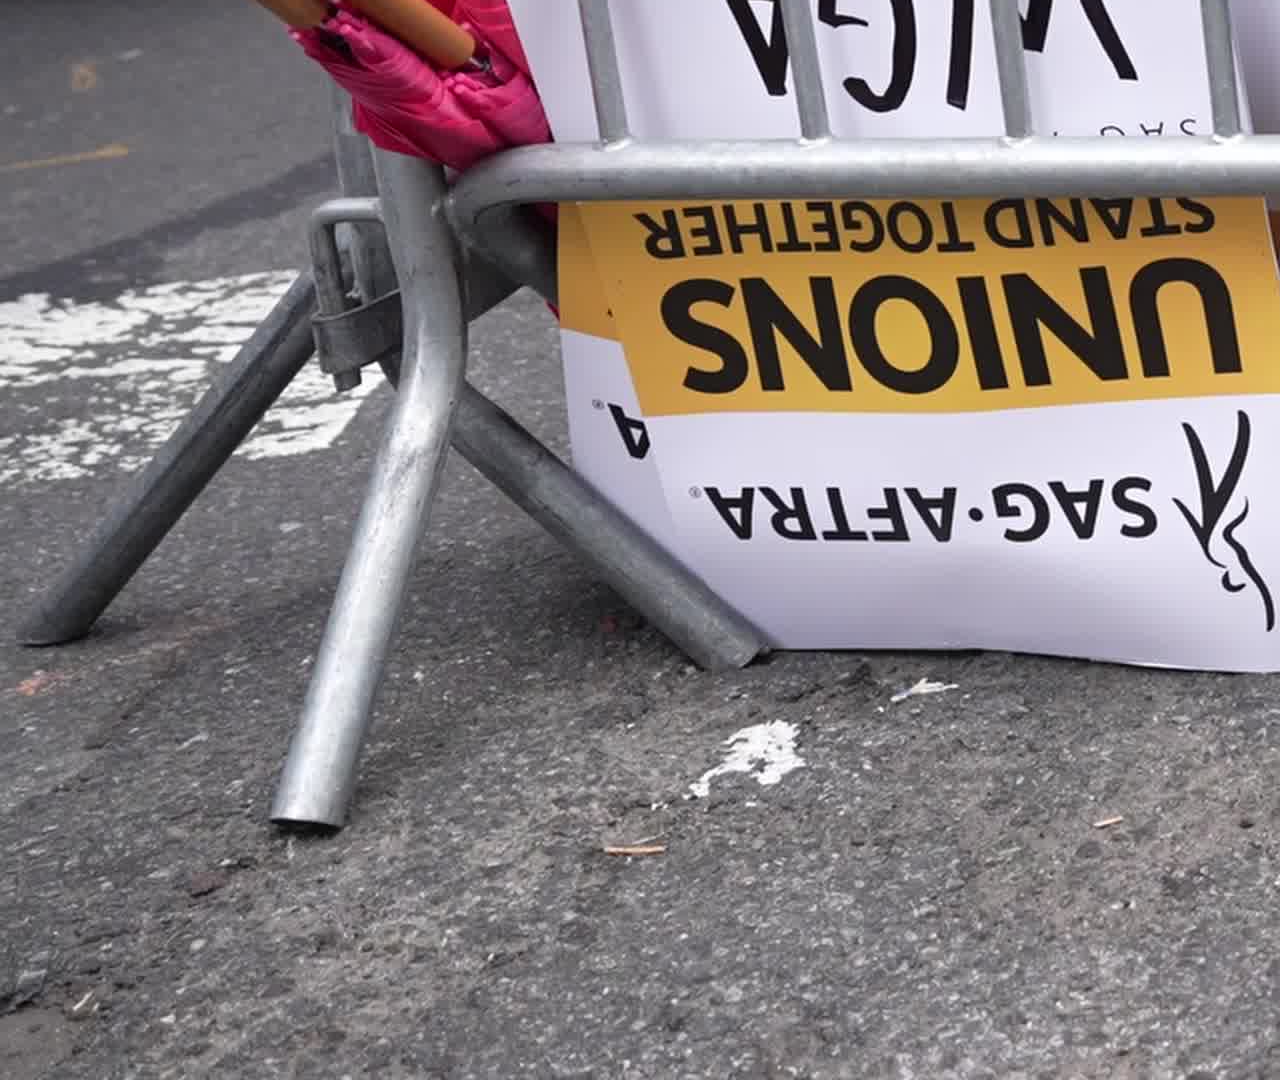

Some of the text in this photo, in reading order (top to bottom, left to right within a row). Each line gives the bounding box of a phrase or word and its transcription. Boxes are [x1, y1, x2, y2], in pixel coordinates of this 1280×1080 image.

[634, 196, 1216, 259] STAND TOGETHER
[659, 256, 1243, 394] UNIONS
